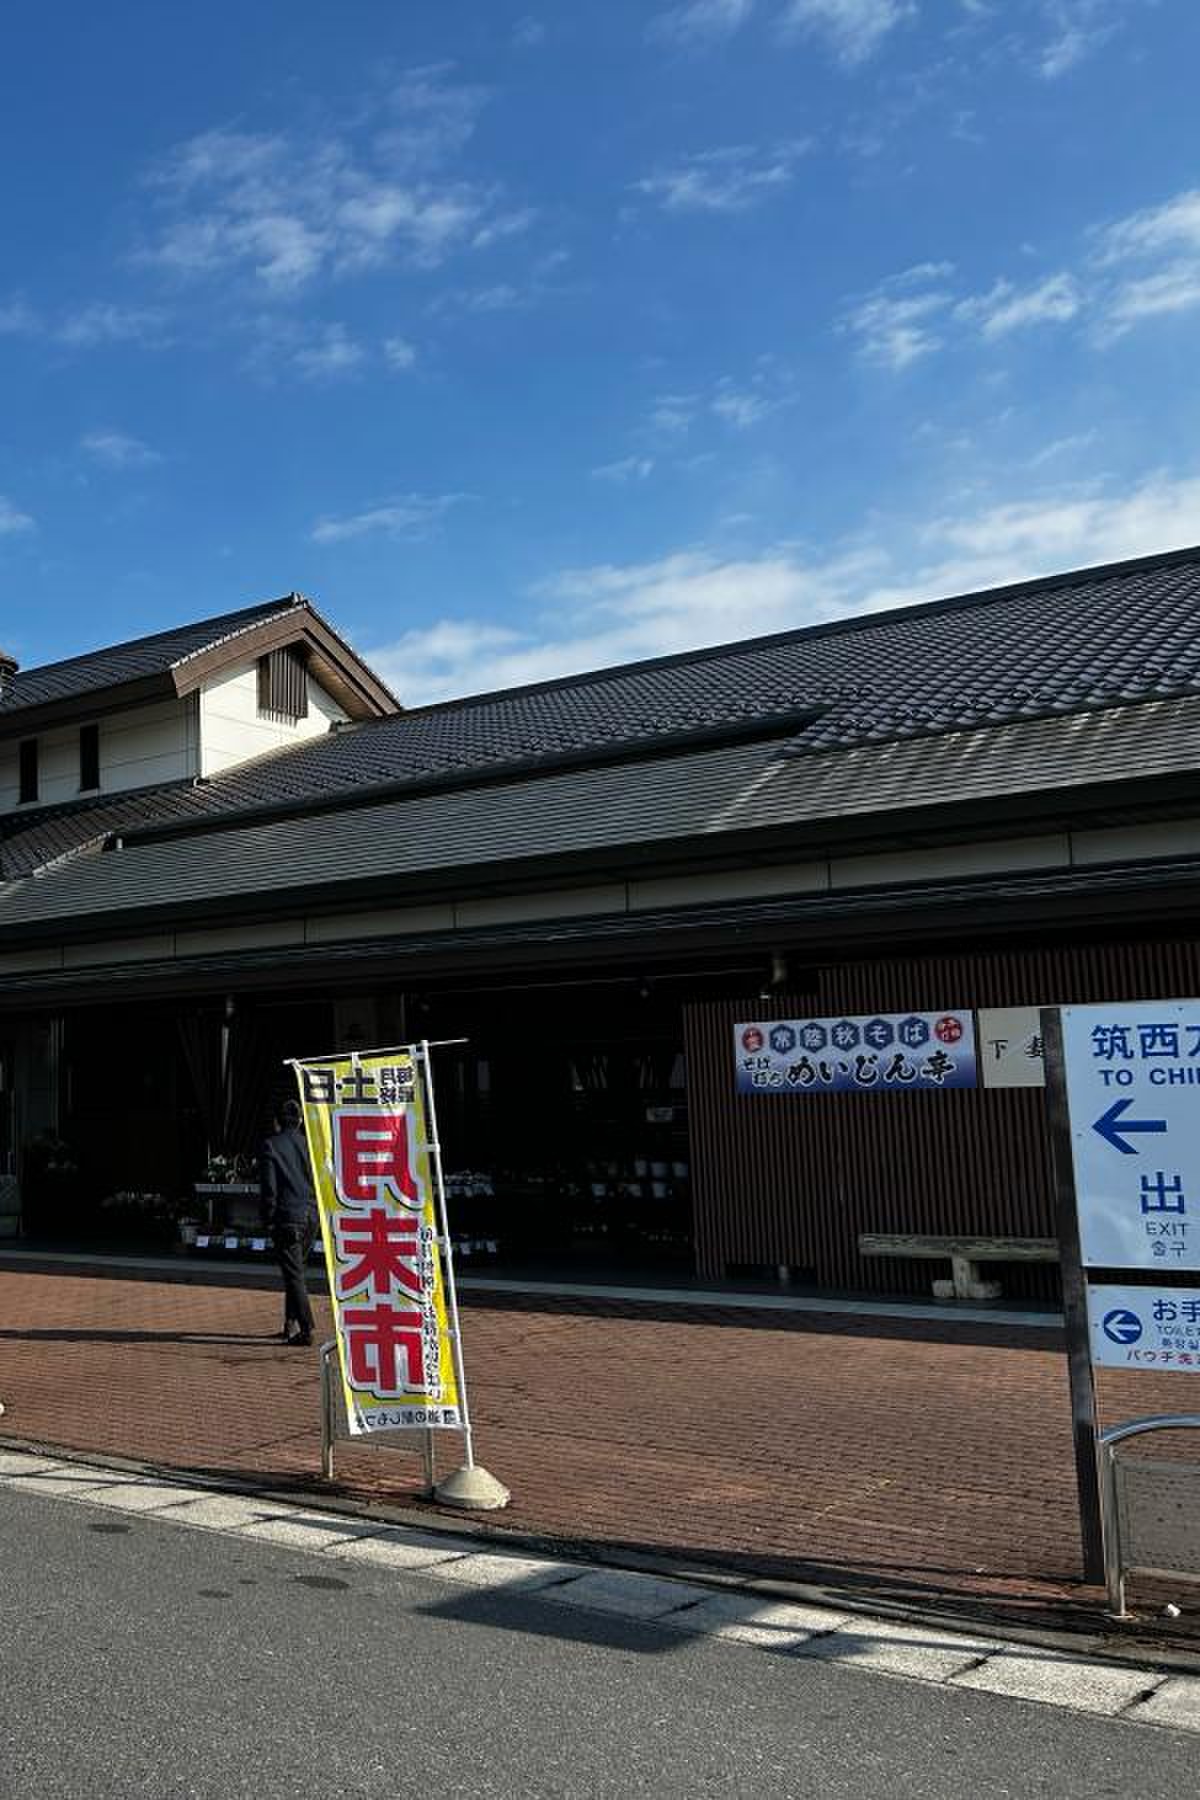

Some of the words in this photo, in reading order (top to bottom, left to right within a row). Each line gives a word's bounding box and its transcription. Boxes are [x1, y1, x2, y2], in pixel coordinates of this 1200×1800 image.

[1099, 1069, 1134, 1087] TO
[1150, 1067, 1200, 1086] CHI
[1139, 1171, 1186, 1215] 出
[1146, 1221, 1190, 1236] EXIT
[1153, 1299, 1200, 1323] お手
